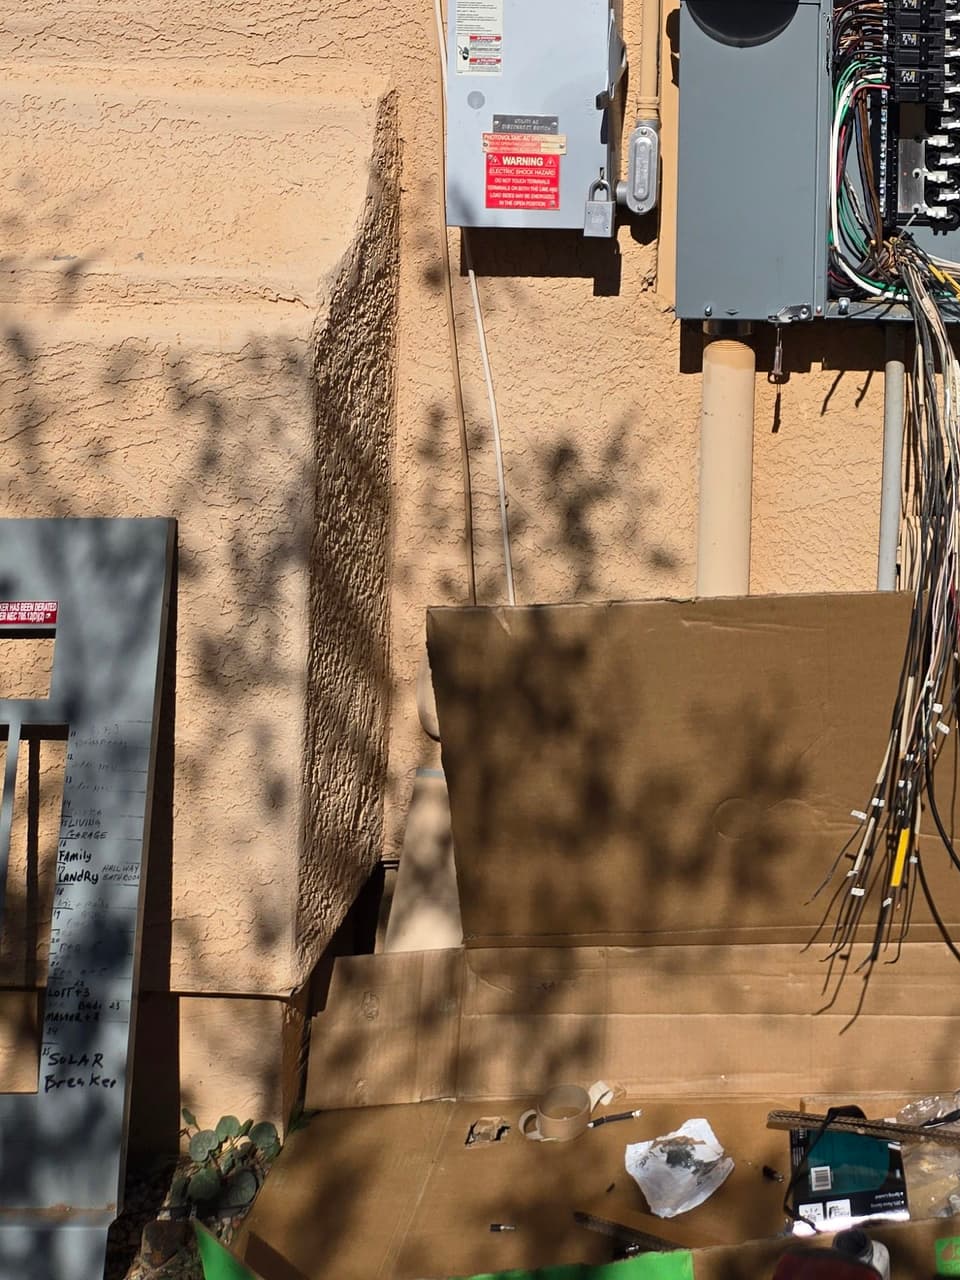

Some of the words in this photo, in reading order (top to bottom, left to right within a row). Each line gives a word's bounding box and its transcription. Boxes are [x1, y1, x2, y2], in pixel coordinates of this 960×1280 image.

[502, 156, 543, 166] WARNING
[20, 603, 34, 611] BEEN
[34, 603, 57, 611] DERATED
